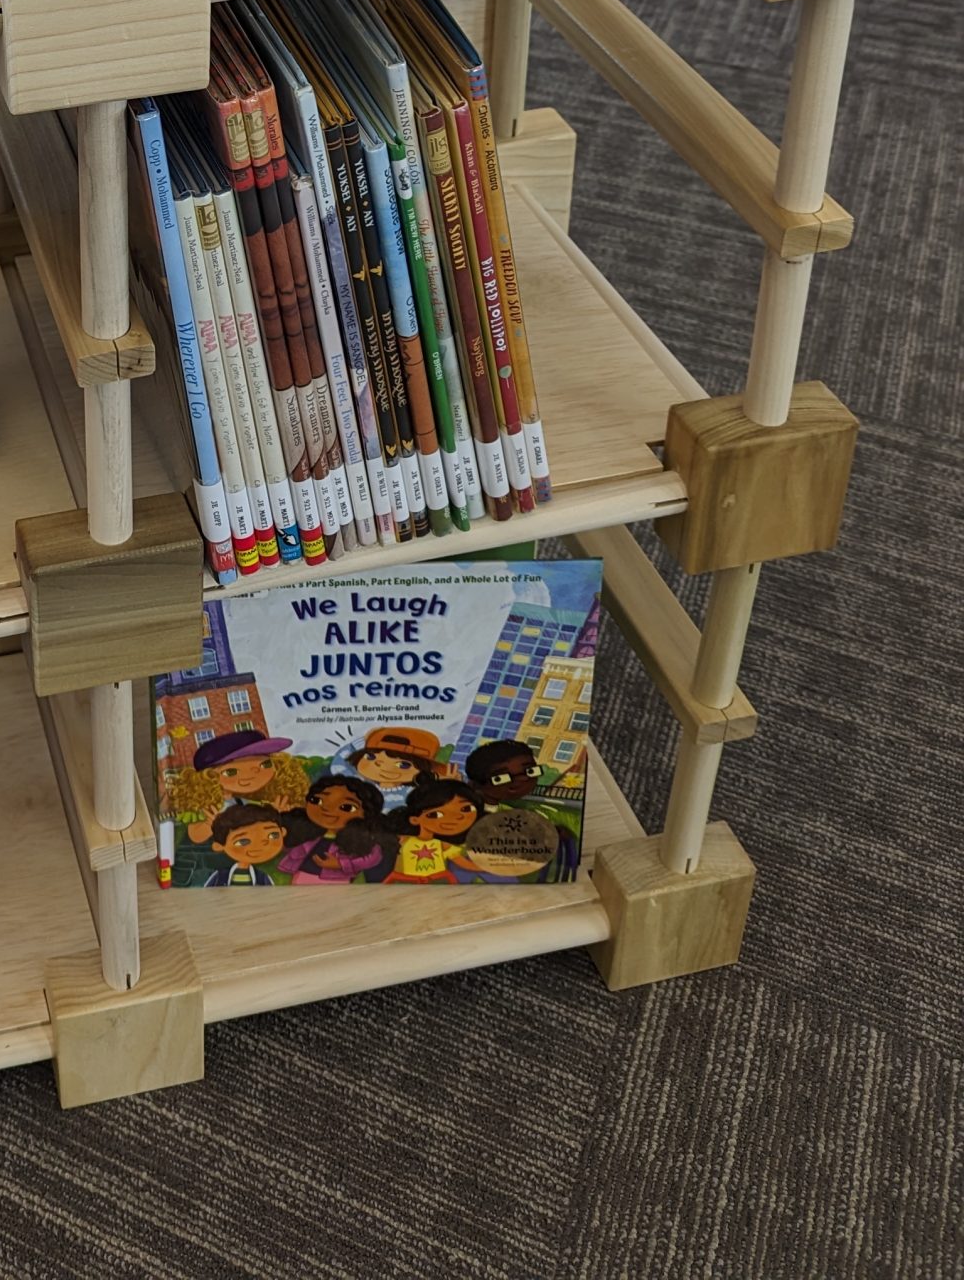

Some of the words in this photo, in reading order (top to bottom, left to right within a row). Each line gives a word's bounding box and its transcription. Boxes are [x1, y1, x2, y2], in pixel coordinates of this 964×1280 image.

[392, 88, 413, 141] JENNINGS
[478, 104, 490, 140] Charles
[149, 139, 162, 168] Copp
[156, 174, 175, 230] Mohammed
[337, 162, 352, 207] YUKSEL
[346, 214, 357, 233] ALY
[441, 176, 460, 222] SECRET
[448, 225, 467, 270] SOCIETY
[500, 249, 518, 297] FREEDOM
[340, 284, 349, 300] MY
[484, 279, 498, 301] RED
[342, 300, 355, 328] NAME
[508, 299, 522, 324] SOUP
[349, 330, 356, 340] IS
[177, 320, 198, 388] Wherever
[191, 399, 206, 419] Go
[351, 342, 368, 386] SANGOEL
[472, 336, 485, 377] Nayberg
[331, 353, 343, 379] Four
[341, 408, 353, 430] Two
[317, 383, 332, 436] Dreamers
[210, 500, 219, 510] JE
[212, 510, 222, 527] COPP
[327, 577, 370, 589] Spanish,
[371, 577, 392, 587] Part
[394, 576, 433, 588] English,
[434, 575, 453, 584] and
[462, 575, 491, 584] Whole
[493, 574, 510, 583] Lot
[511, 573, 522, 582] of
[524, 573, 542, 583] Fun
[291, 597, 337, 620] We
[351, 592, 448, 617] Laugh
[324, 620, 420, 645] ALIKE
[299, 650, 443, 678] JUNTOS
[282, 685, 337, 708] nos
[349, 677, 457, 703] reímos
[321, 706, 353, 714] Carmen
[404, 712, 445, 721] Bermudez
